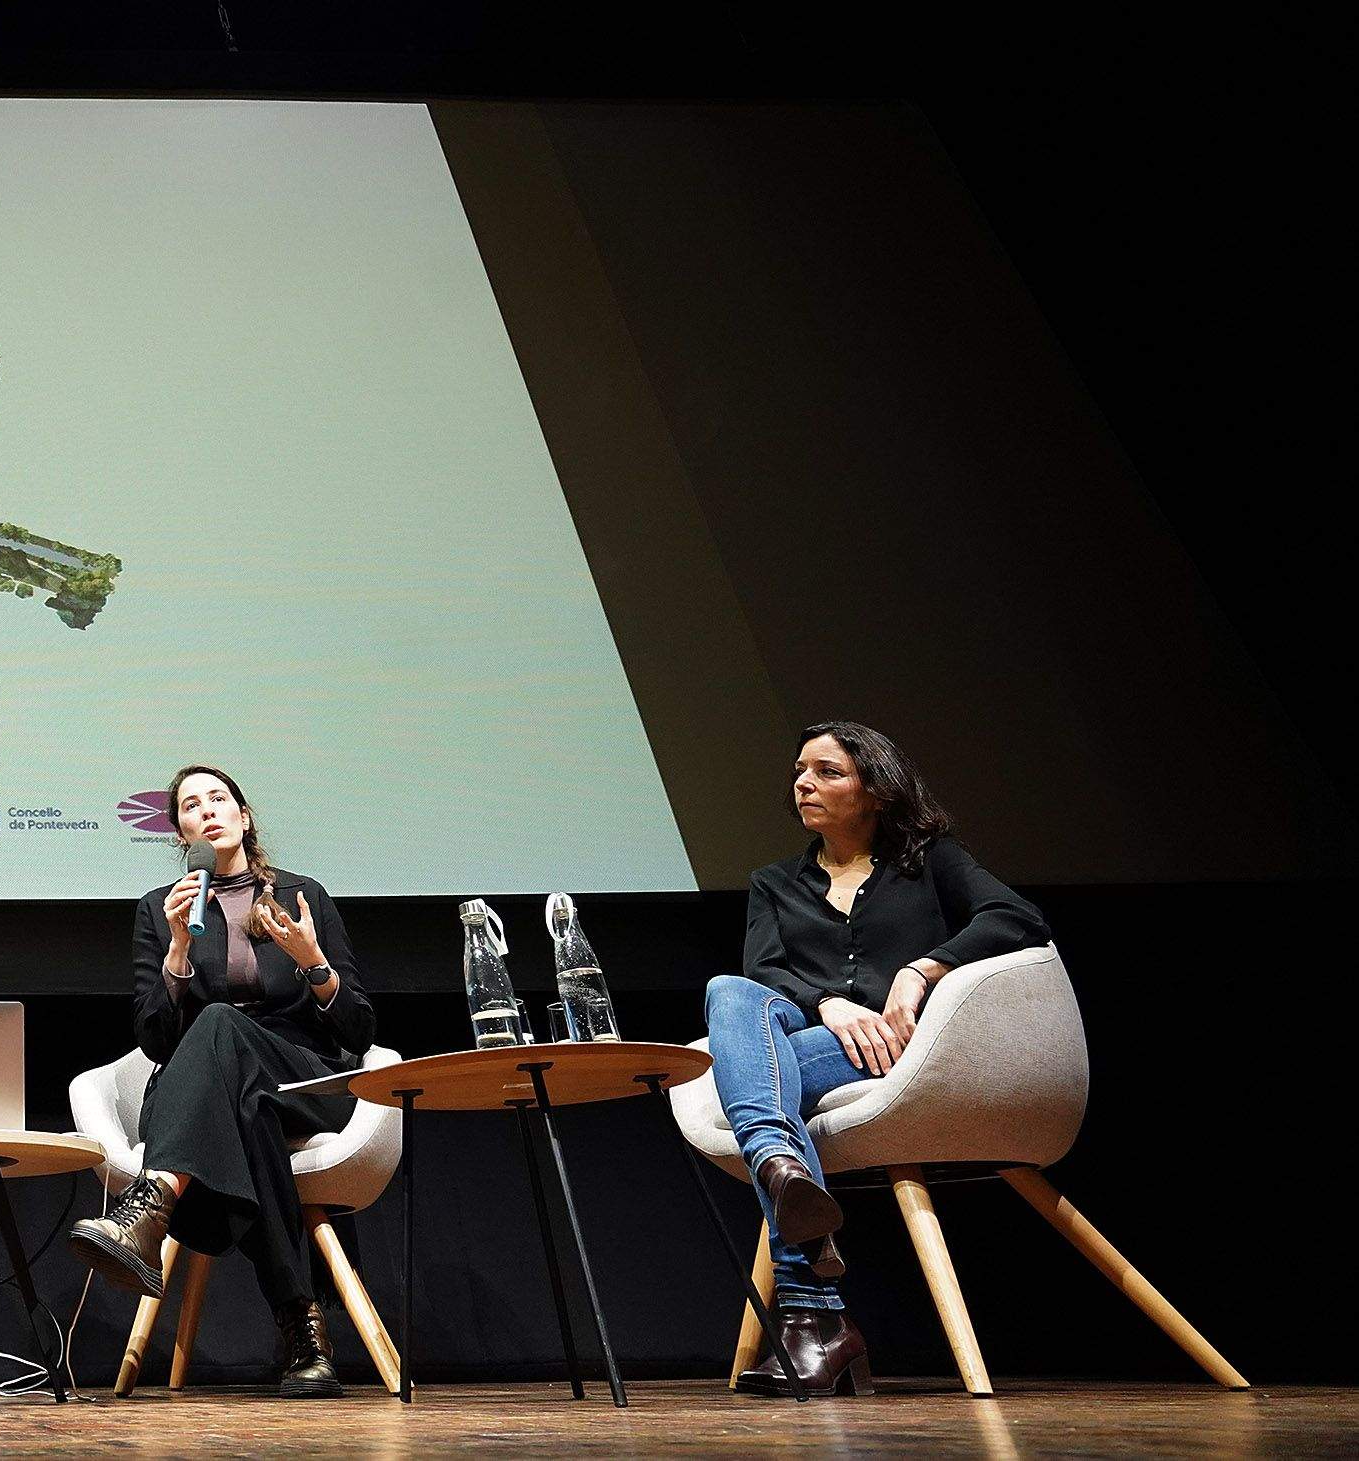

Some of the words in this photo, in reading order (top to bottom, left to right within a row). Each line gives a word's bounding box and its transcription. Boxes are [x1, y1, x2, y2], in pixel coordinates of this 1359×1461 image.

[7, 806, 63, 818] Concello
[8, 818, 26, 830] de
[28, 818, 100, 831] Pontevedra
